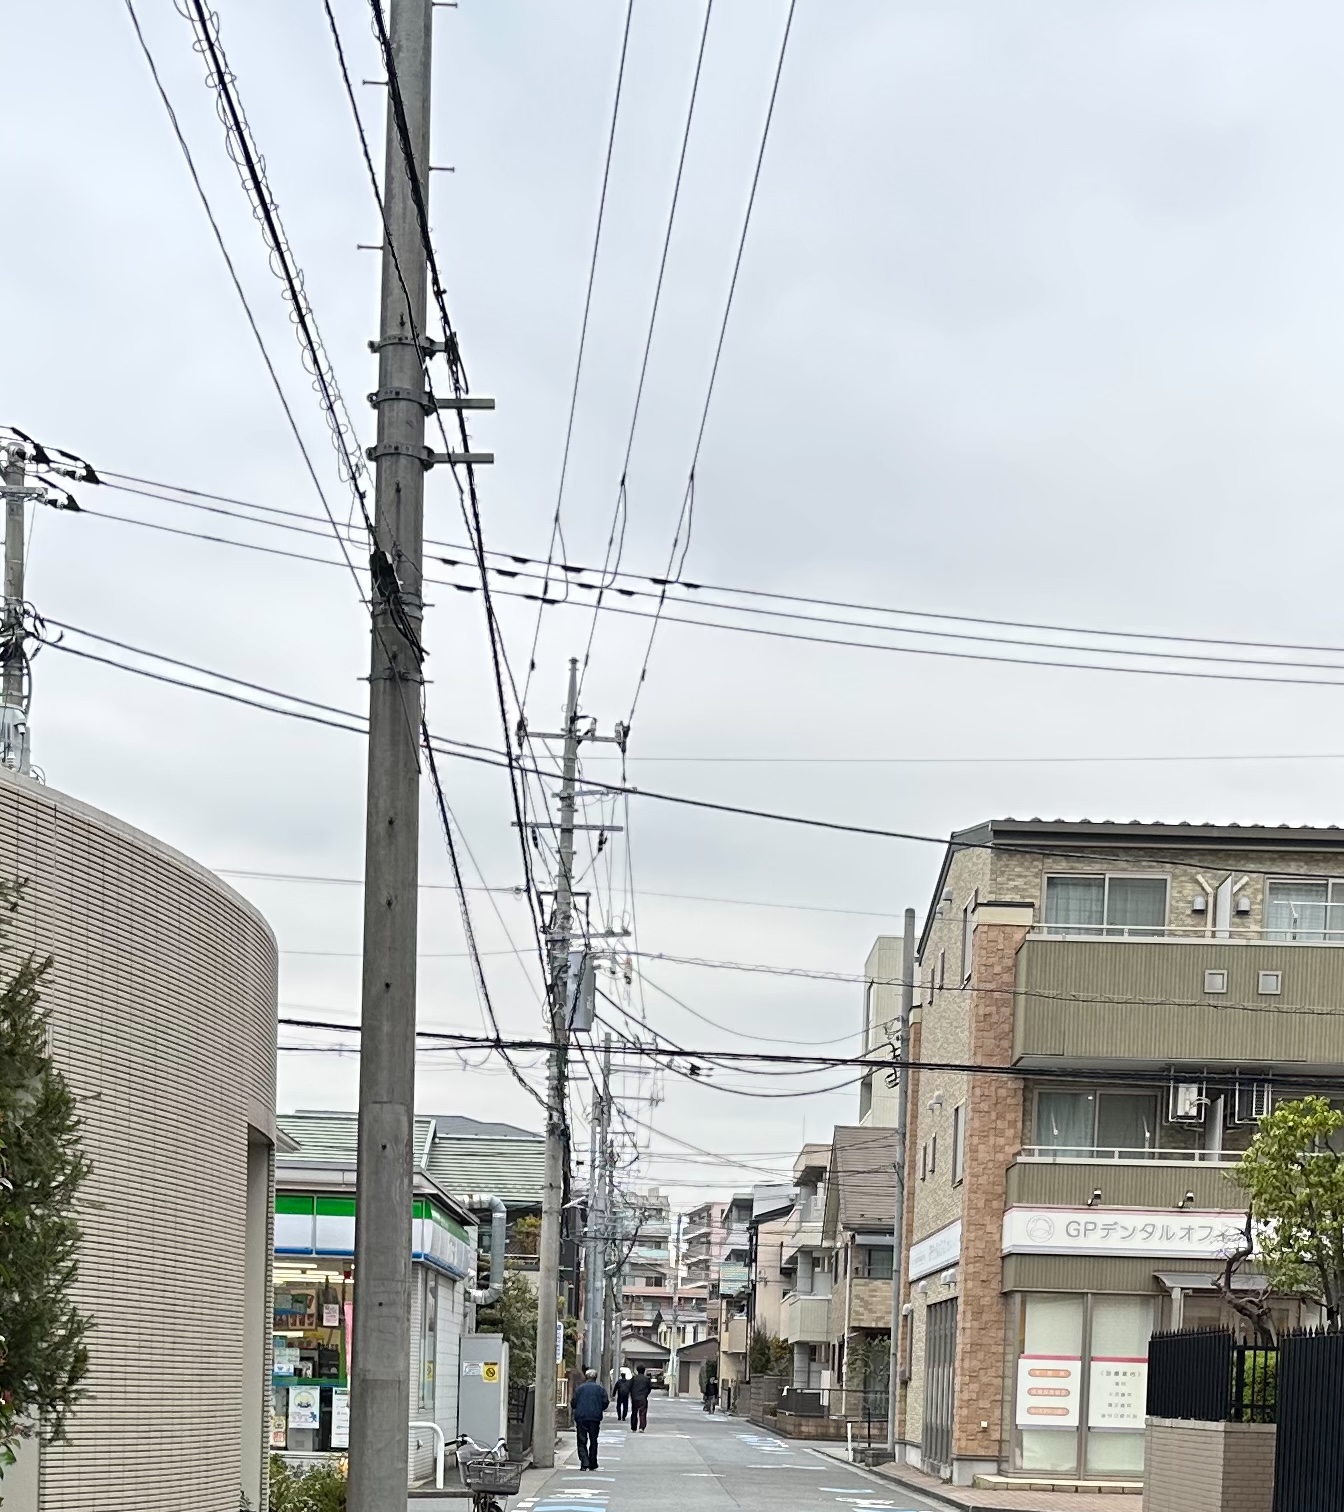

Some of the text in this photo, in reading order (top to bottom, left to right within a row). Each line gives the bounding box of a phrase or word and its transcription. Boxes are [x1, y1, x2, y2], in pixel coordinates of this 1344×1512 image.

[1065, 1220, 1244, 1243] GPデンタルオフィ
